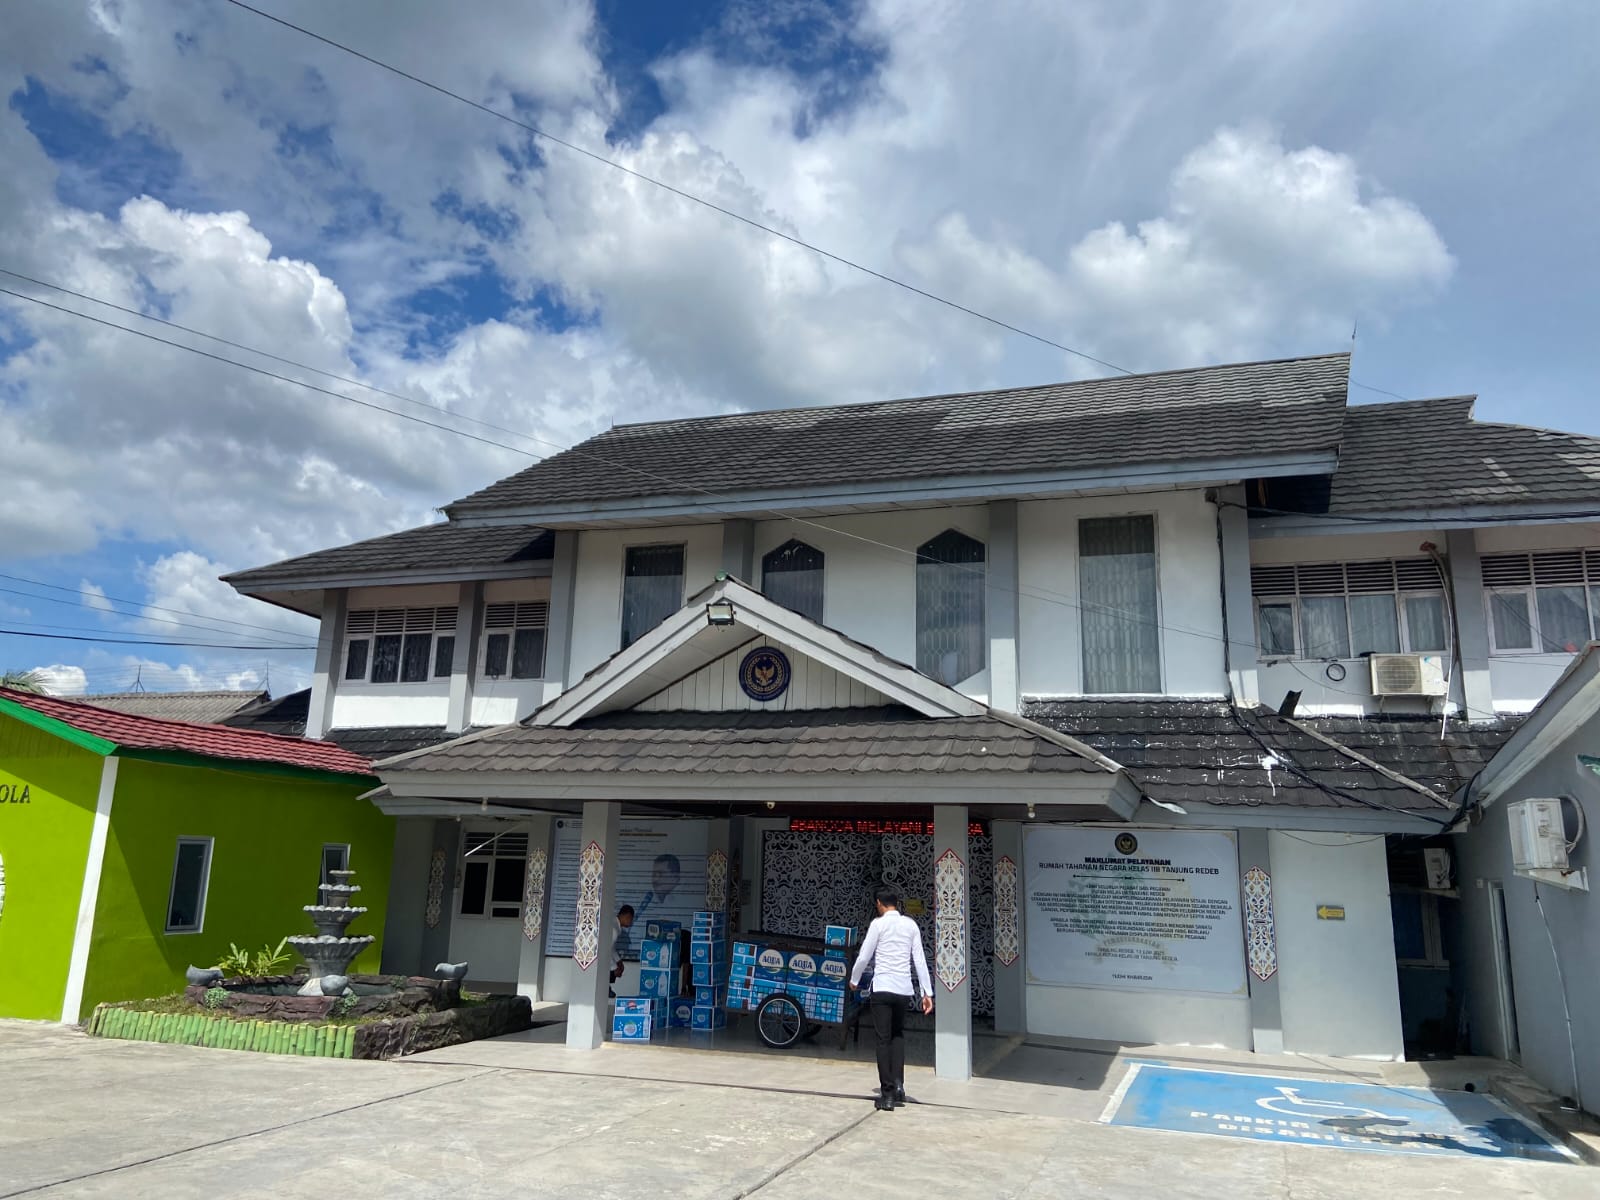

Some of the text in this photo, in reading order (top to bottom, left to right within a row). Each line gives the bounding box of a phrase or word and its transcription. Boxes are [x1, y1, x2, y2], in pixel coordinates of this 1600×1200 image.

[763, 956, 780, 965] AQUA
[792, 960, 812, 969] AQUA
[825, 964, 843, 973] AQUA
[1190, 1110, 1309, 1128] PARKIR
